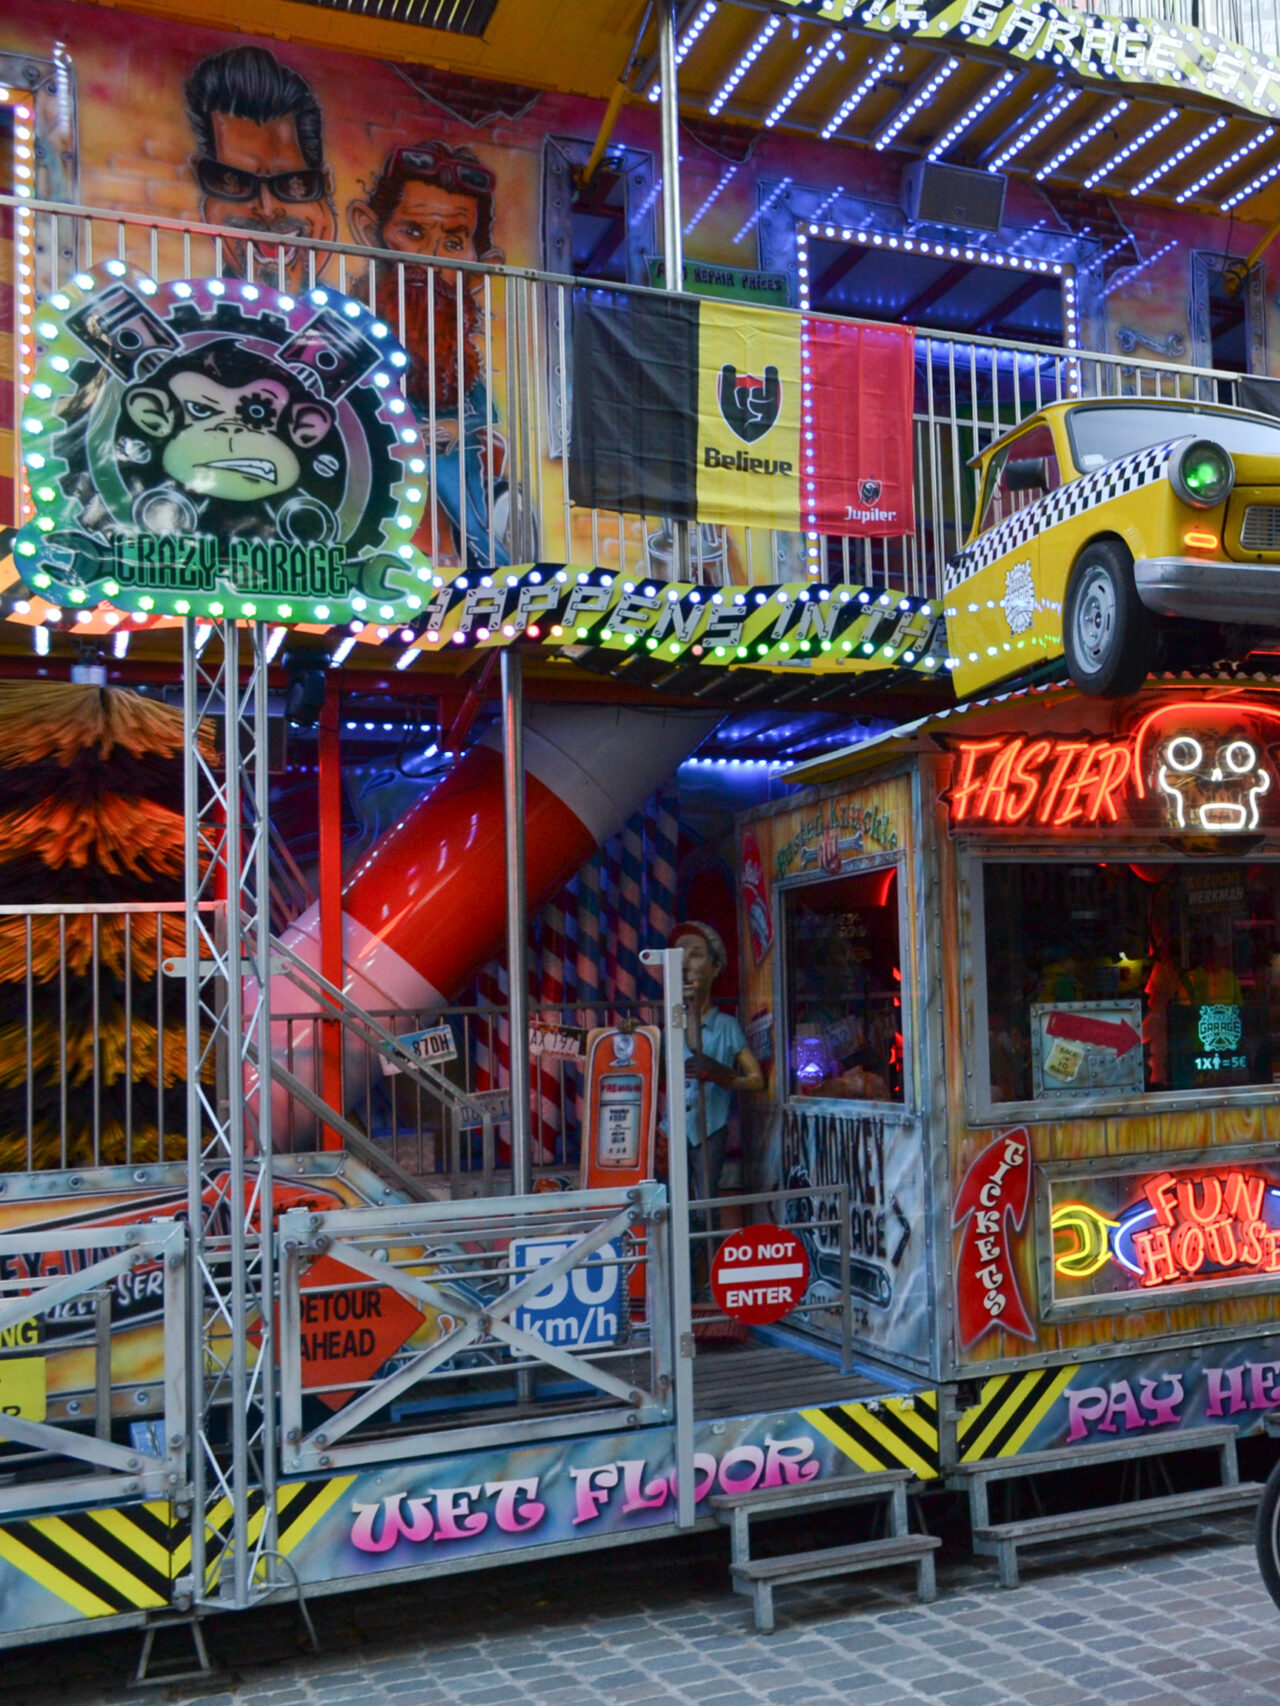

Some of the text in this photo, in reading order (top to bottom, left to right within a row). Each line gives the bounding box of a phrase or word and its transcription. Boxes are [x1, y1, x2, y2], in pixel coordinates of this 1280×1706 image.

[960, 0, 1183, 72] GARAGE
[694, 268, 735, 287] REPAIR
[704, 446, 793, 477] Believe
[843, 505, 897, 523] Jupiler
[771, 602, 841, 641] IN
[952, 736, 1136, 828] FASTER
[1199, 1021, 1242, 1034] GARAGE
[1143, 1172, 1267, 1225] FUN
[818, 1200, 887, 1258] GAAGE
[975, 1138, 1027, 1317] TICKETS
[724, 1242, 796, 1263] DO NOT
[522, 1240, 619, 1311] 50
[726, 1286, 793, 1308] ENTER
[300, 1328, 376, 1363] AHEAD
[523, 1306, 618, 1346] km/h
[1063, 1373, 1185, 1443] PAY
[350, 1435, 820, 1553] WET FLOOR
